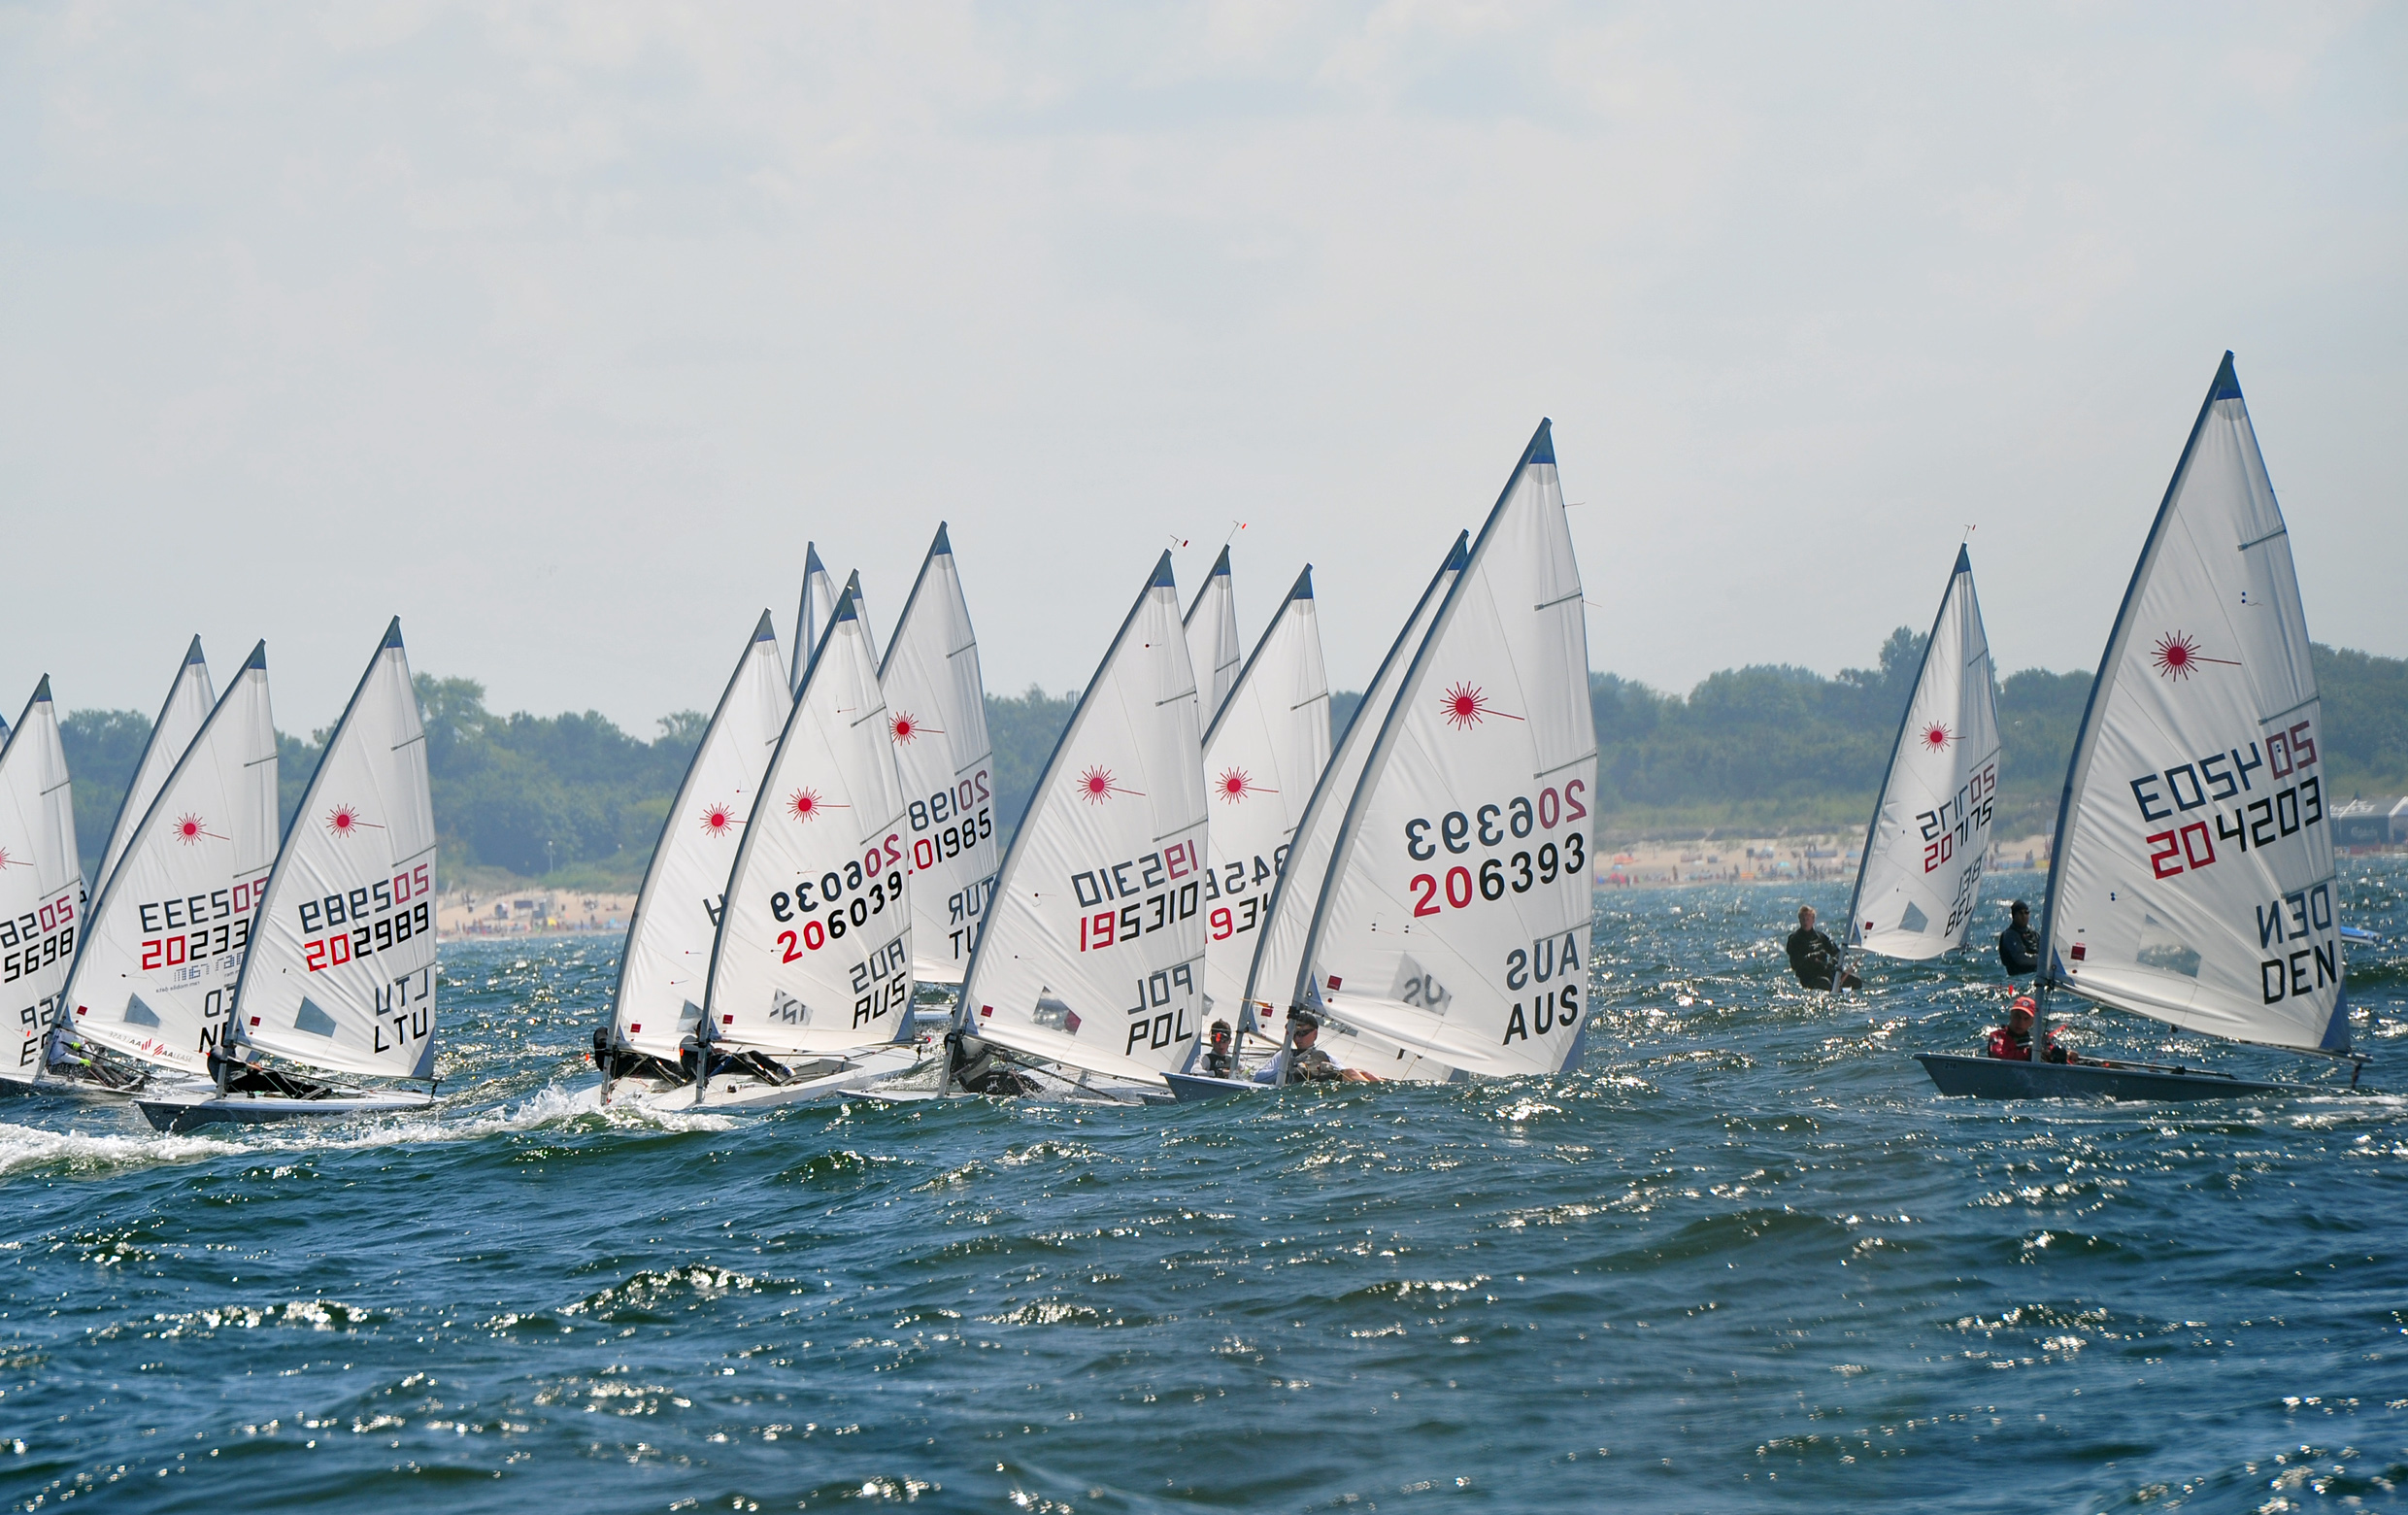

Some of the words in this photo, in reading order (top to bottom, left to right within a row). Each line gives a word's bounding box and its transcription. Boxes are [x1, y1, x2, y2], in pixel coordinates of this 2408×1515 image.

[1924, 795, 1993, 874] 207175
[2146, 774, 2323, 880] 204203
[1409, 832, 1586, 918] 206393
[304, 901, 429, 972] 202989
[777, 870, 903, 964] 206039
[1080, 880, 1198, 952] 195310
[1205, 892, 1269, 945] 93
[1944, 892, 1973, 939] BEL
[5, 926, 74, 983] 5698
[2261, 940, 2337, 1005] DEN
[375, 1007, 427, 1054] LTU
[853, 971, 906, 1030] AUS
[1502, 984, 1578, 1046] AUS
[162, 1050, 193, 1062] AALEASE
[1125, 1008, 1192, 1056] POL
